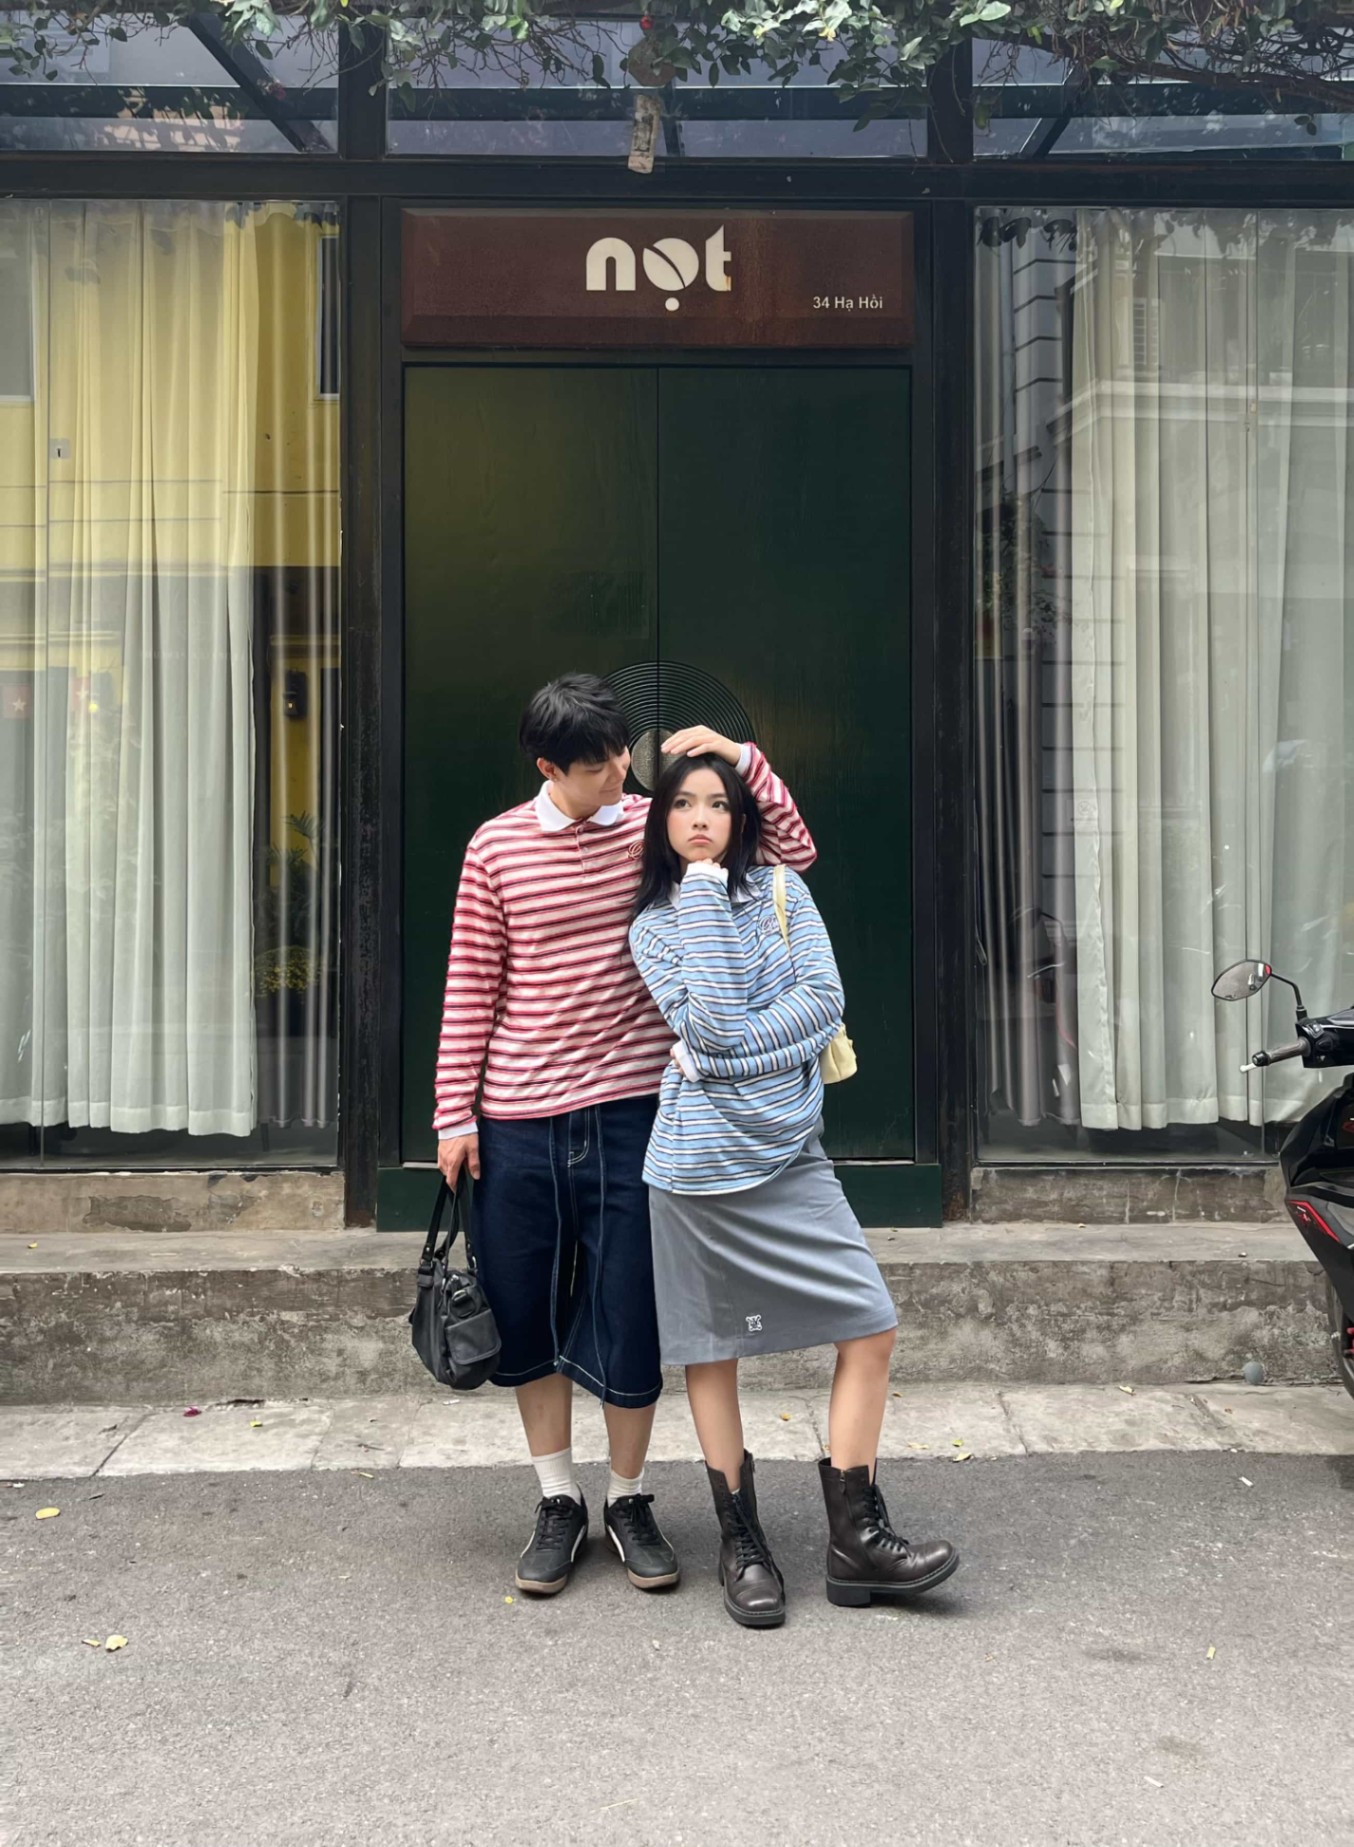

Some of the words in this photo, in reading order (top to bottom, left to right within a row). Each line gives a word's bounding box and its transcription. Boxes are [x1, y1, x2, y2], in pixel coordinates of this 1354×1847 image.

[813, 296, 830, 309] 34
[834, 296, 854, 312] Hạ
[858, 293, 883, 309] Hồi
